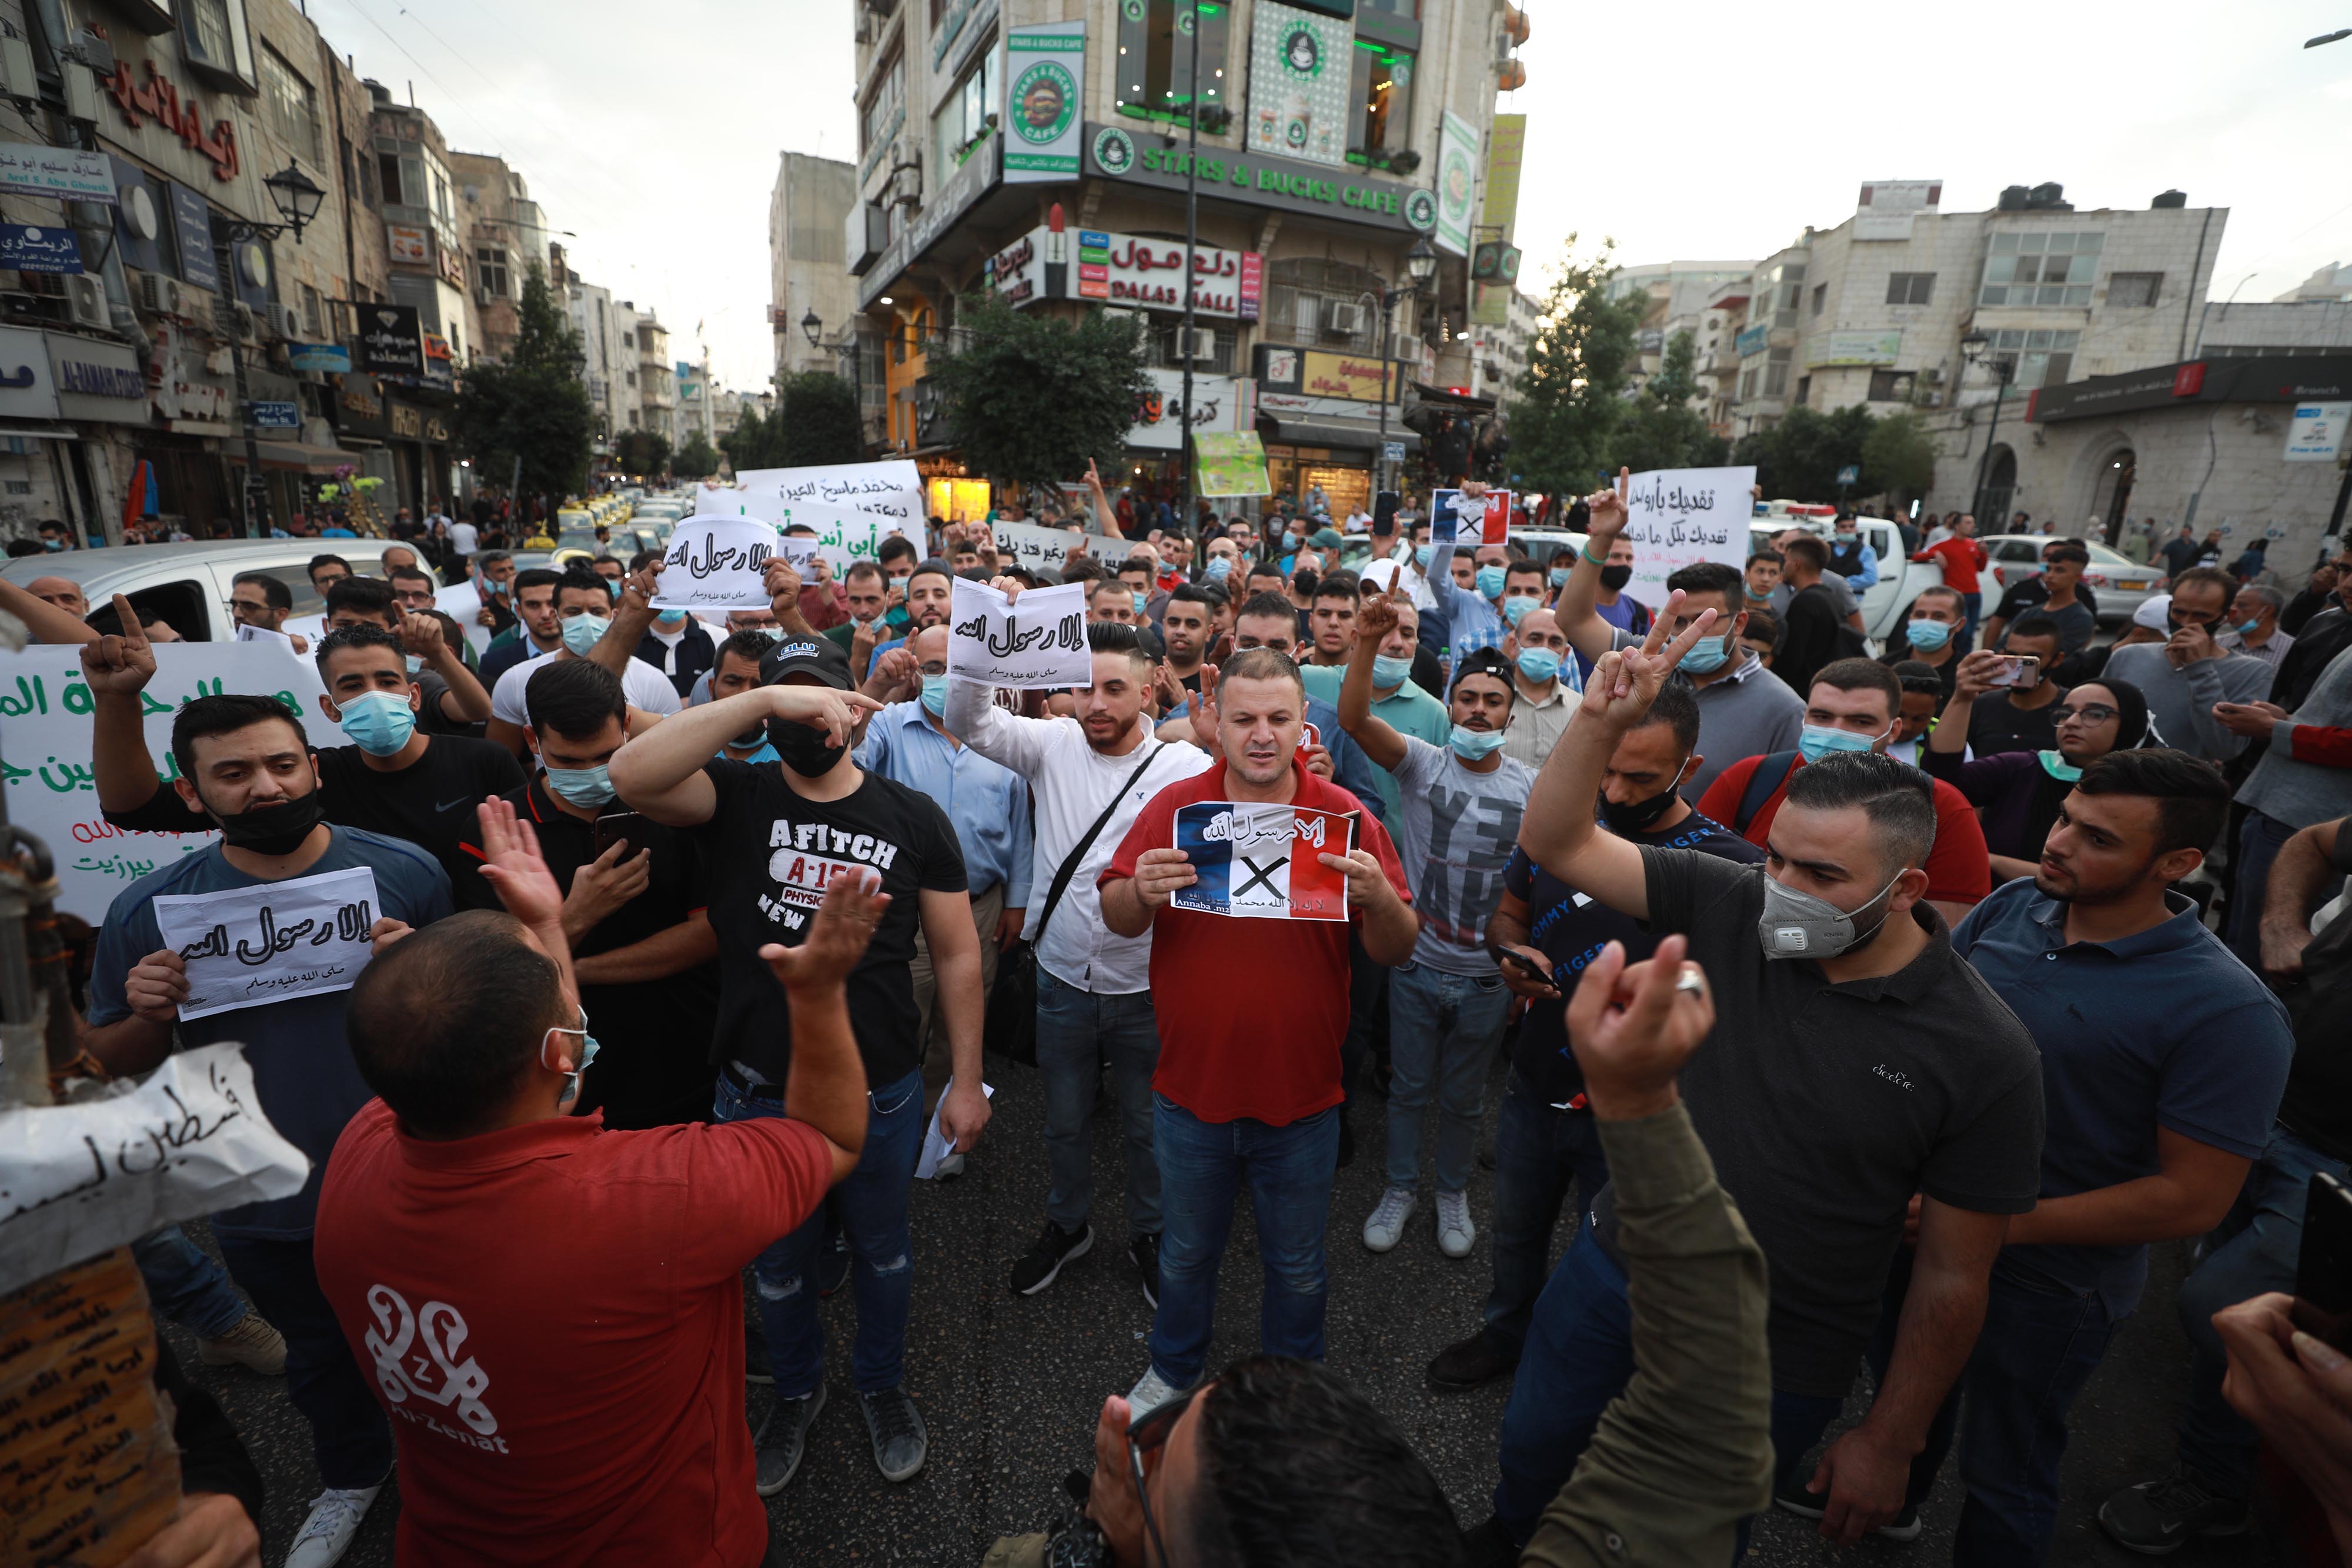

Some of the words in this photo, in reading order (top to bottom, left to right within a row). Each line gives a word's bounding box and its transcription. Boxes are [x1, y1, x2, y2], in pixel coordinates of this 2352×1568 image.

[1010, 37, 1032, 48] STARS
[1039, 38, 1063, 48] BUCKS
[1064, 39, 1082, 48] CAFE
[1015, 69, 1039, 105] STARS
[1048, 65, 1073, 100] BUCKS
[1024, 124, 1060, 140] CAFE
[41, 161, 68, 175] سليم
[1142, 147, 1225, 182] STARS
[1231, 164, 1251, 186] &
[1258, 169, 1338, 203] BUCKS
[8, 173, 28, 182] Aref
[47, 178, 67, 187] Abu
[70, 180, 109, 192] Ghoush
[1, 234, 73, 253] الريماوي
[1111, 239, 1182, 271] مول
[1112, 280, 1177, 304] DALA3
[1649, 523, 1662, 545] ما
[690, 531, 747, 580] رسول
[707, 592, 720, 602] عليه
[720, 591, 731, 600] الله
[732, 590, 747, 600] صلى
[955, 614, 987, 643] الله
[988, 614, 1056, 658] رسول
[1058, 612, 1084, 653] إلا
[780, 641, 816, 656] BLU
[988, 666, 1008, 678] وسلم
[1010, 672, 1024, 681] عليه
[1026, 670, 1038, 679] الله
[1040, 667, 1058, 678] صلى
[1234, 815, 1295, 847] رسول
[1296, 816, 1324, 847] إلا
[769, 818, 898, 870] AFITCH
[72, 854, 155, 881] بيرزيت
[784, 889, 824, 907] PHYSIC
[1175, 898, 1212, 911] Annaba
[1205, 893, 1232, 907] رسول
[1235, 897, 1266, 908] محمد
[1268, 897, 1285, 908] الله
[757, 892, 806, 931] NEW
[337, 900, 372, 944] إلا
[1531, 898, 1571, 946] OMMY
[236, 905, 334, 966] رسول
[278, 974, 299, 988] عليه
[300, 969, 319, 982] الله
[322, 965, 345, 980] صلى
[246, 976, 276, 995] وسلم
[412, 1355, 433, 1383] Z
